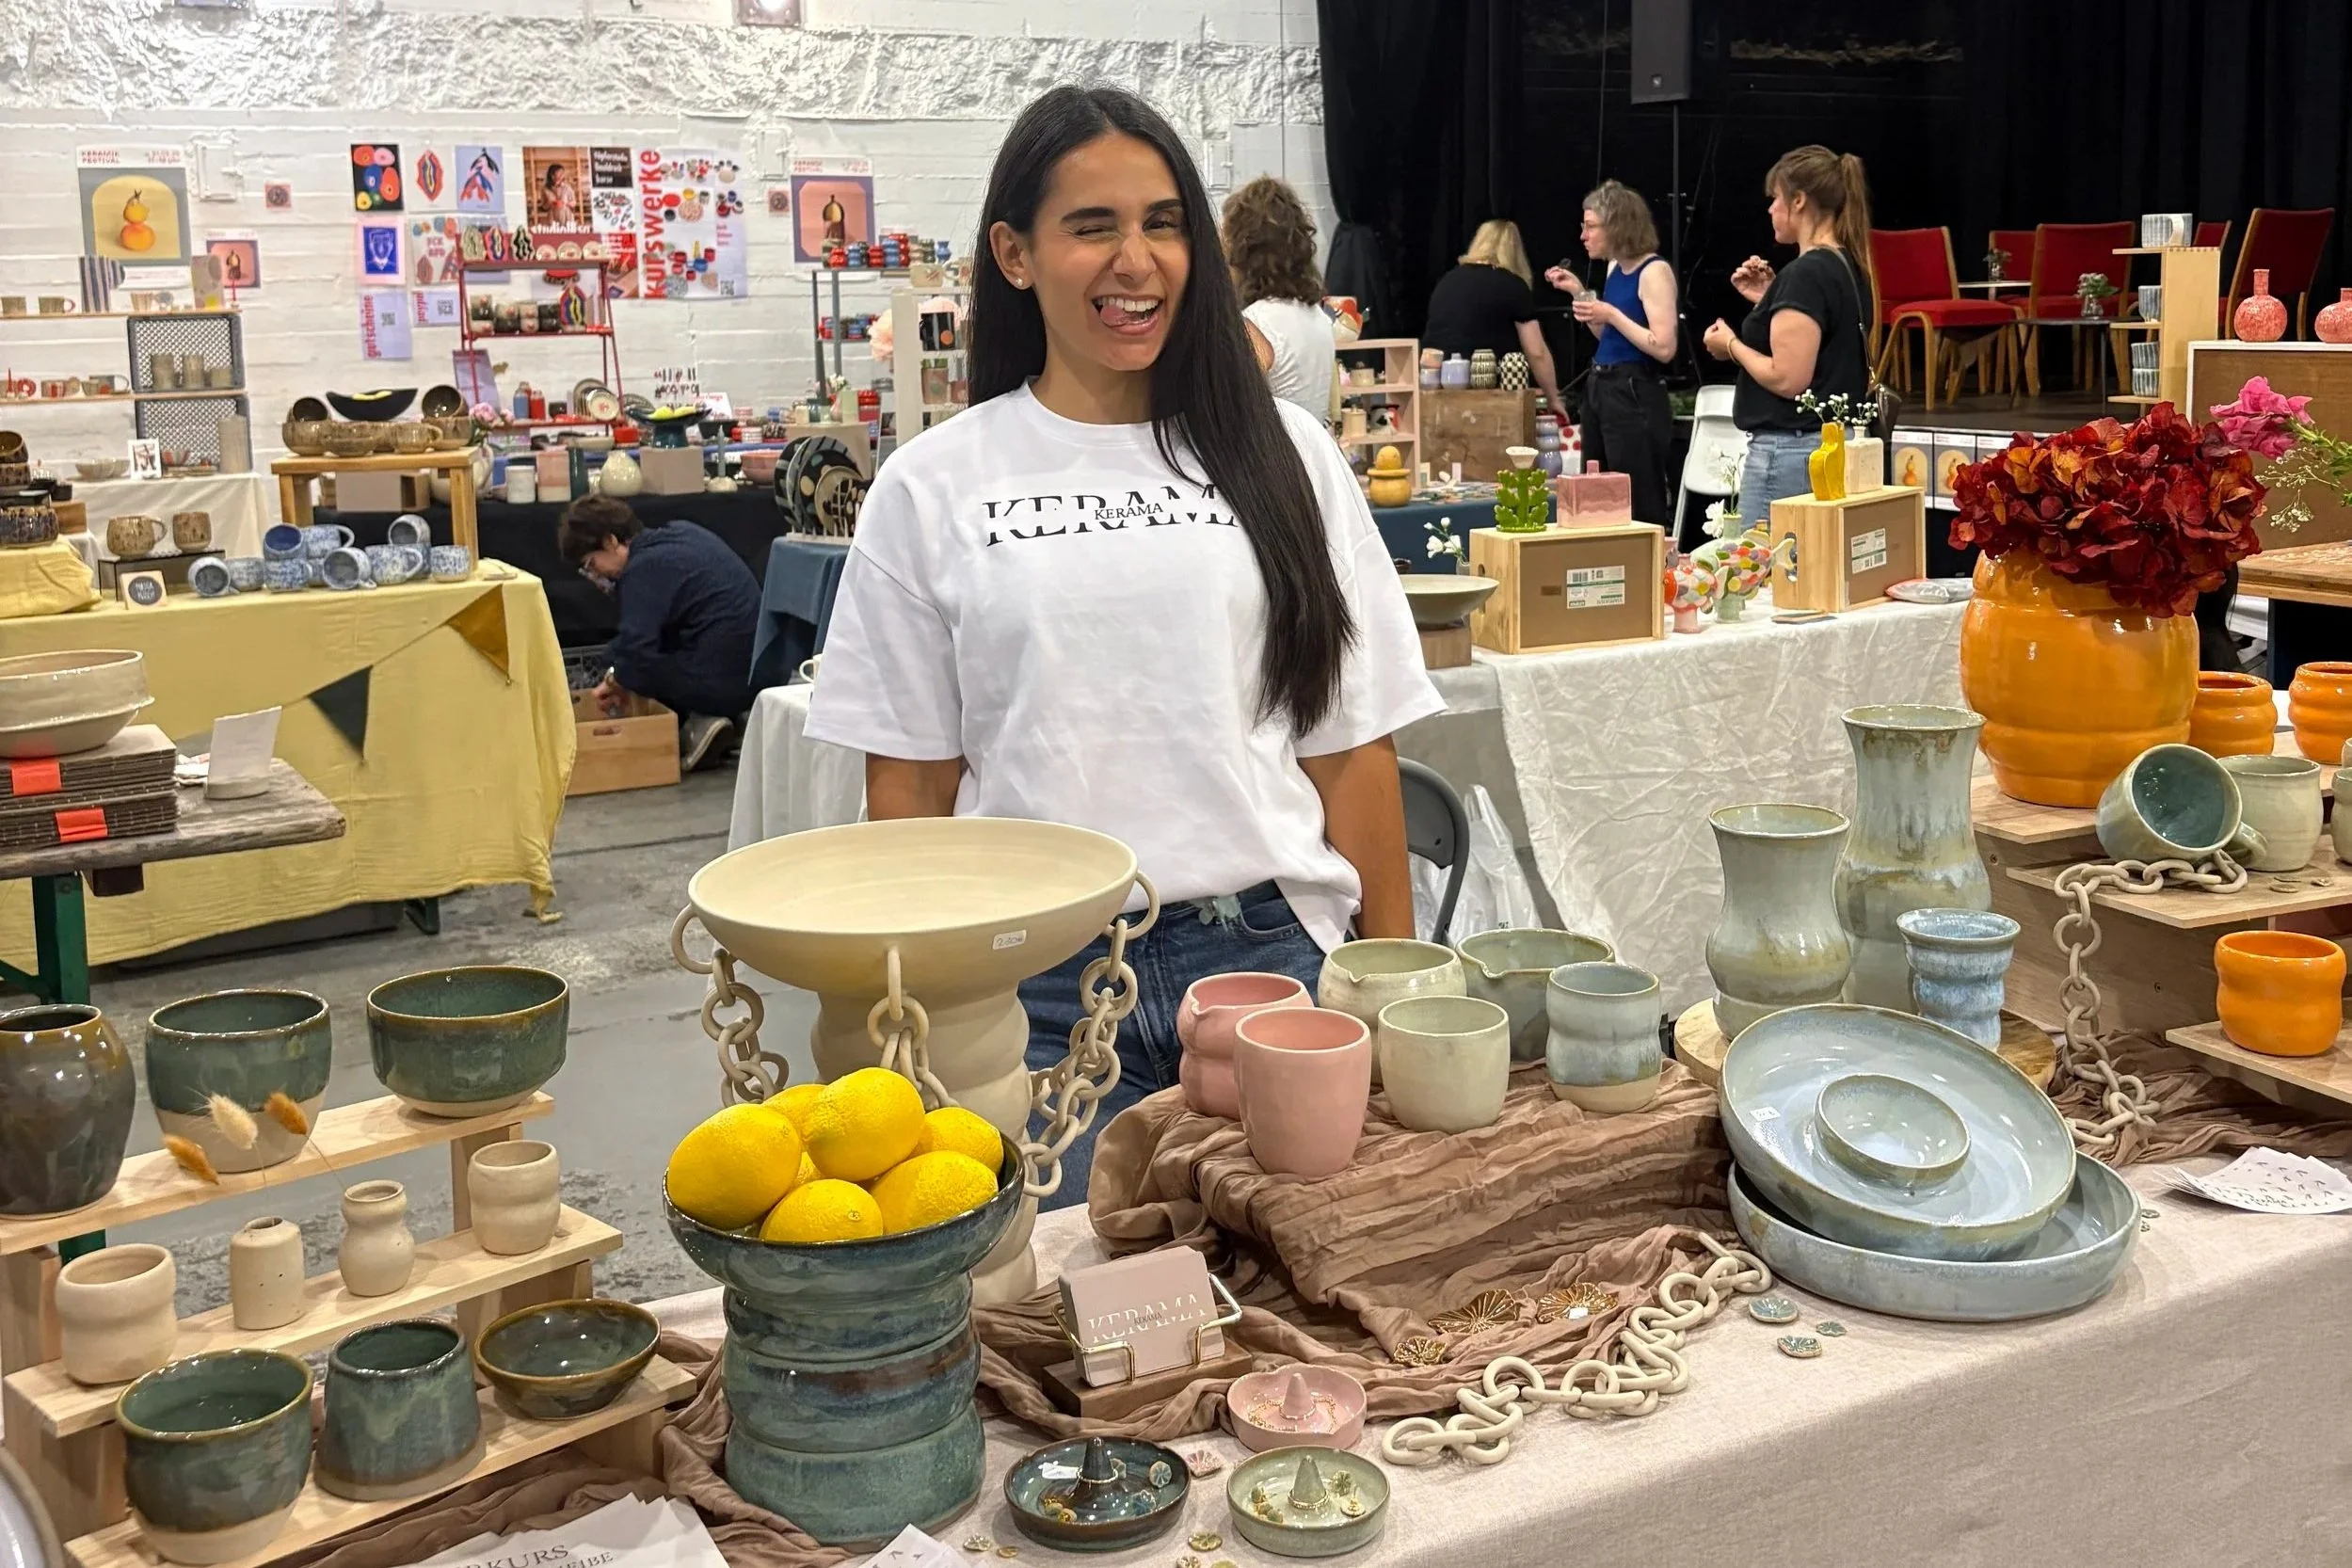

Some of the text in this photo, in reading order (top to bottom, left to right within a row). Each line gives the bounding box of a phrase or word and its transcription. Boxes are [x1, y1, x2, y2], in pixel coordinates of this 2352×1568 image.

[639, 150, 667, 298] kurswerke
[361, 296, 380, 359] gutscheine
[1095, 503, 1164, 520] KERAMA
